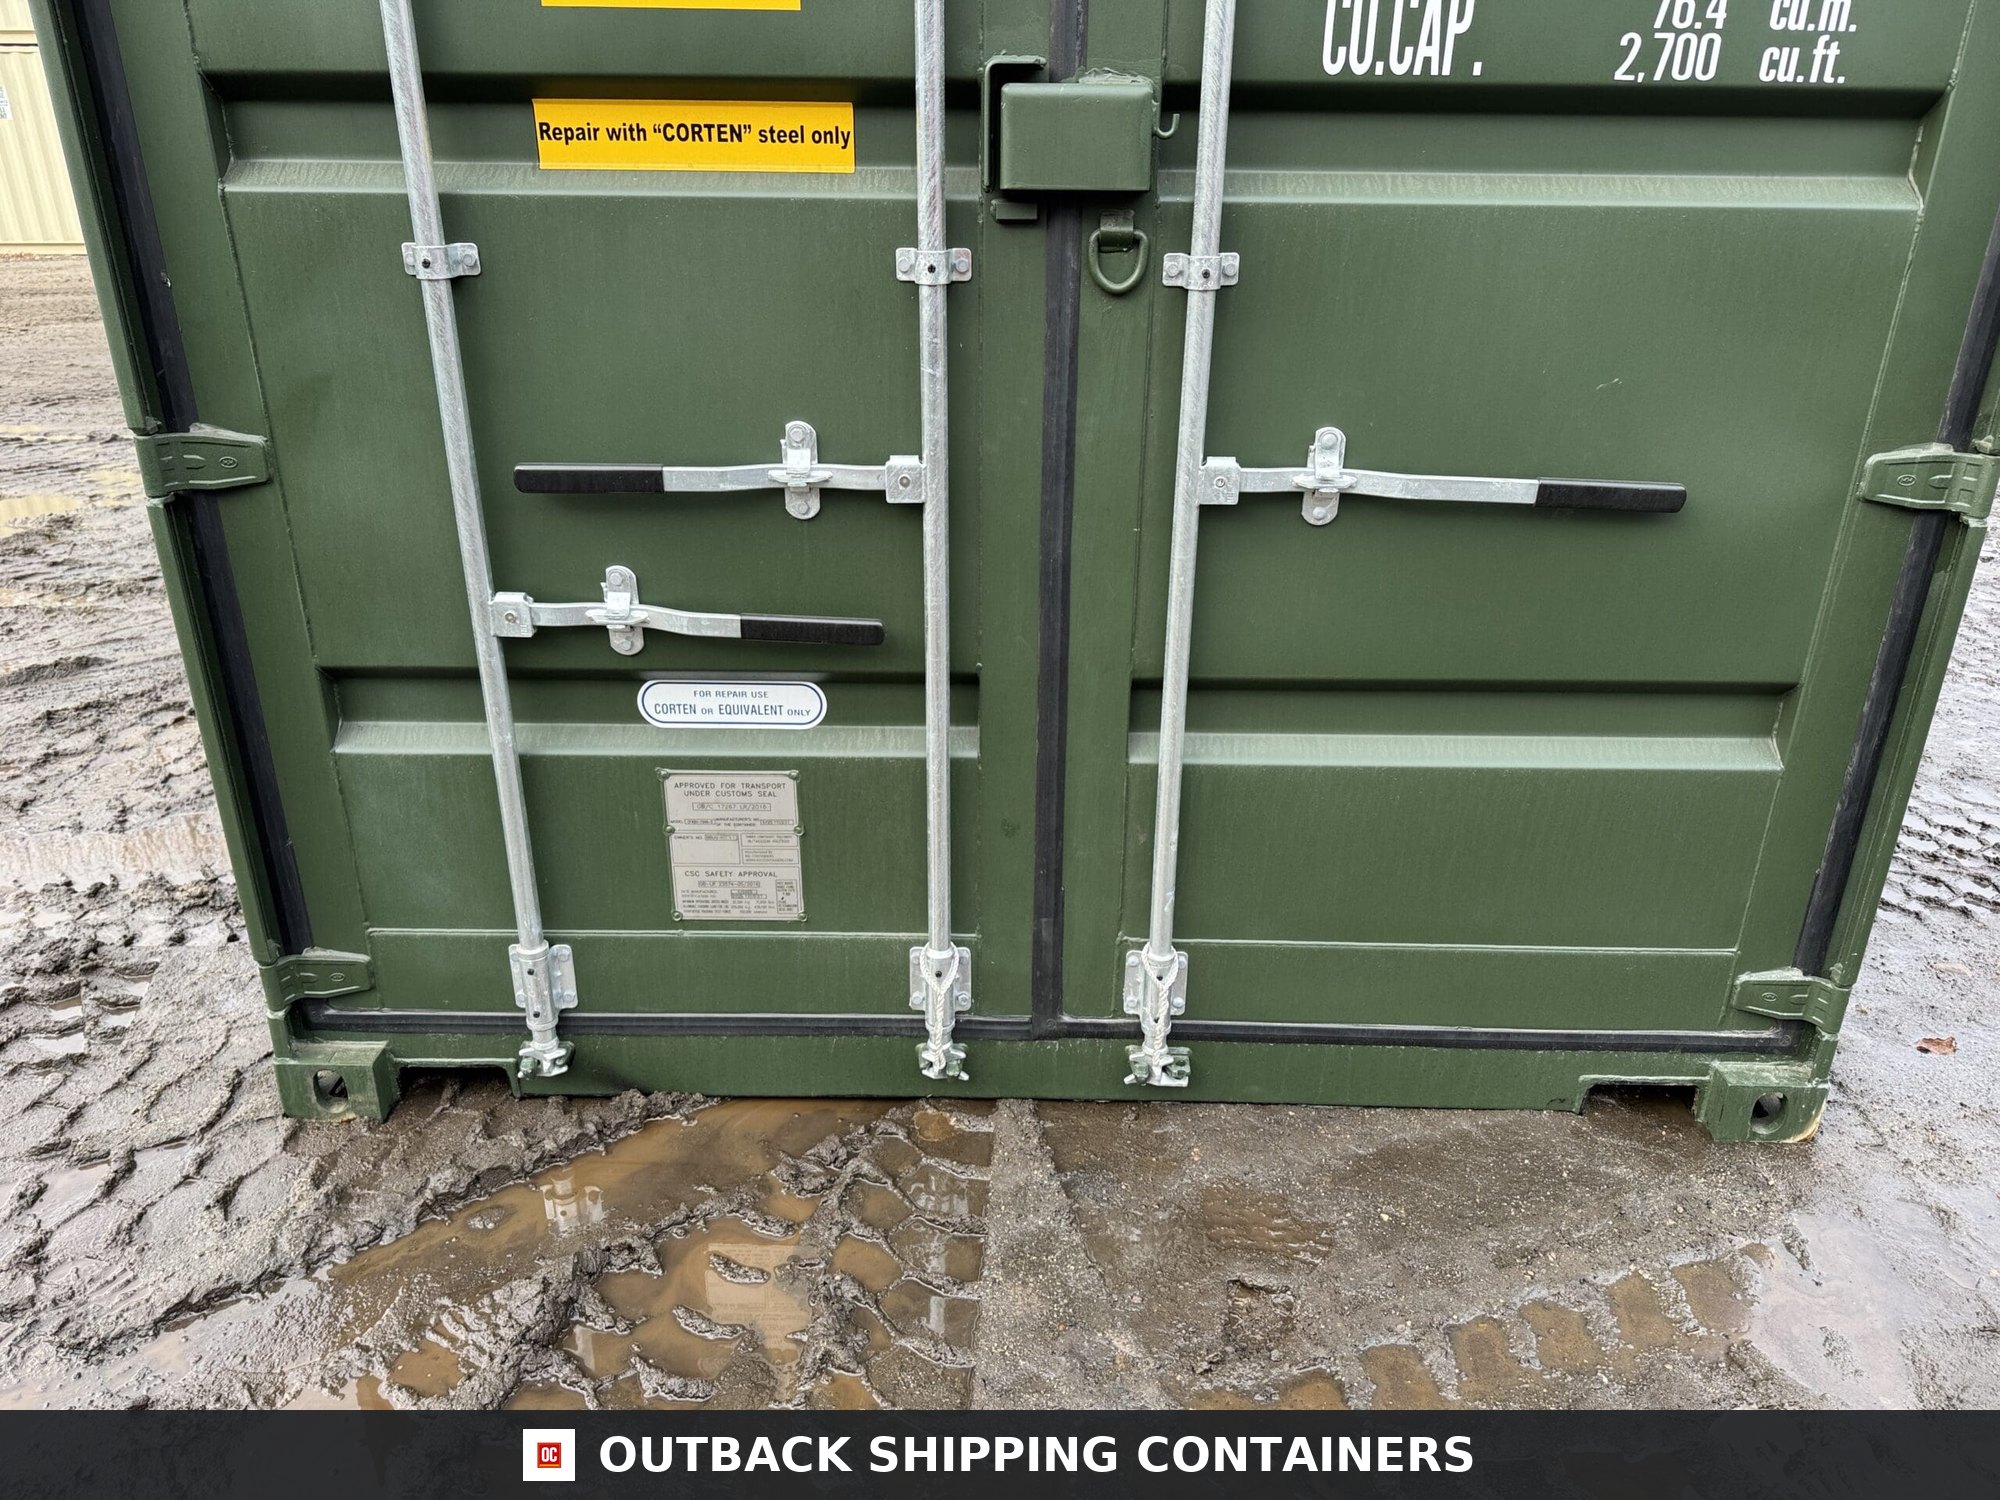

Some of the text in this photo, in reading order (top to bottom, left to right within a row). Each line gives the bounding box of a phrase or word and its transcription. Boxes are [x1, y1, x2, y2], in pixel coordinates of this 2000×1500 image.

[1769, 0, 1857, 32] cu.m.
[1613, 32, 1846, 84] 2,700 cu.ft.
[538, 121, 851, 149] Repair with “CORTEN” steel only
[693, 690, 712, 698] FOR
[715, 690, 748, 698] REPAIR
[654, 703, 811, 717] CORTEN OR EQUIVALENT ONLY
[741, 782, 786, 790] TRANSPORT
[684, 870, 778, 878] CSC SAFETY APPROVAL
